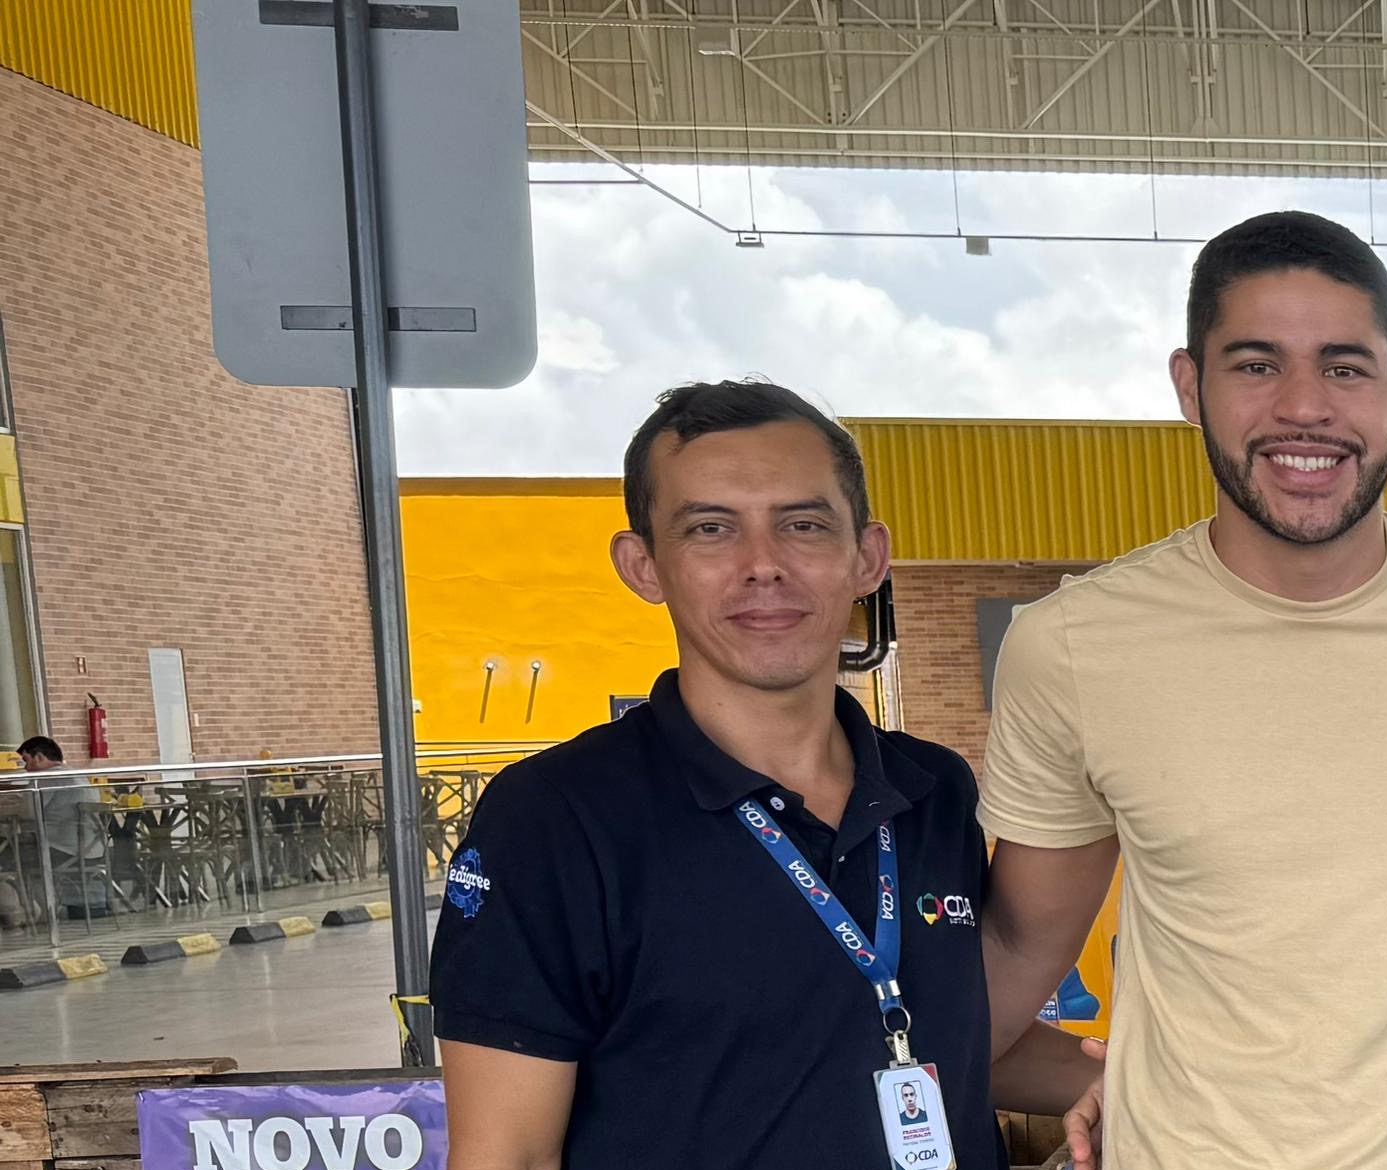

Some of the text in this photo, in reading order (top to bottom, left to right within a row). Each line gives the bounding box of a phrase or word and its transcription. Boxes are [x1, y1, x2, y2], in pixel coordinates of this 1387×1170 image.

[739, 801, 767, 829] CDA
[879, 825, 891, 852] CDA
[448, 864, 491, 890] edigree
[788, 860, 816, 889] CDA
[881, 891, 894, 920] CDA
[943, 895, 975, 920] CDA
[835, 921, 863, 950] CDA
[918, 1148, 938, 1161] CDA
